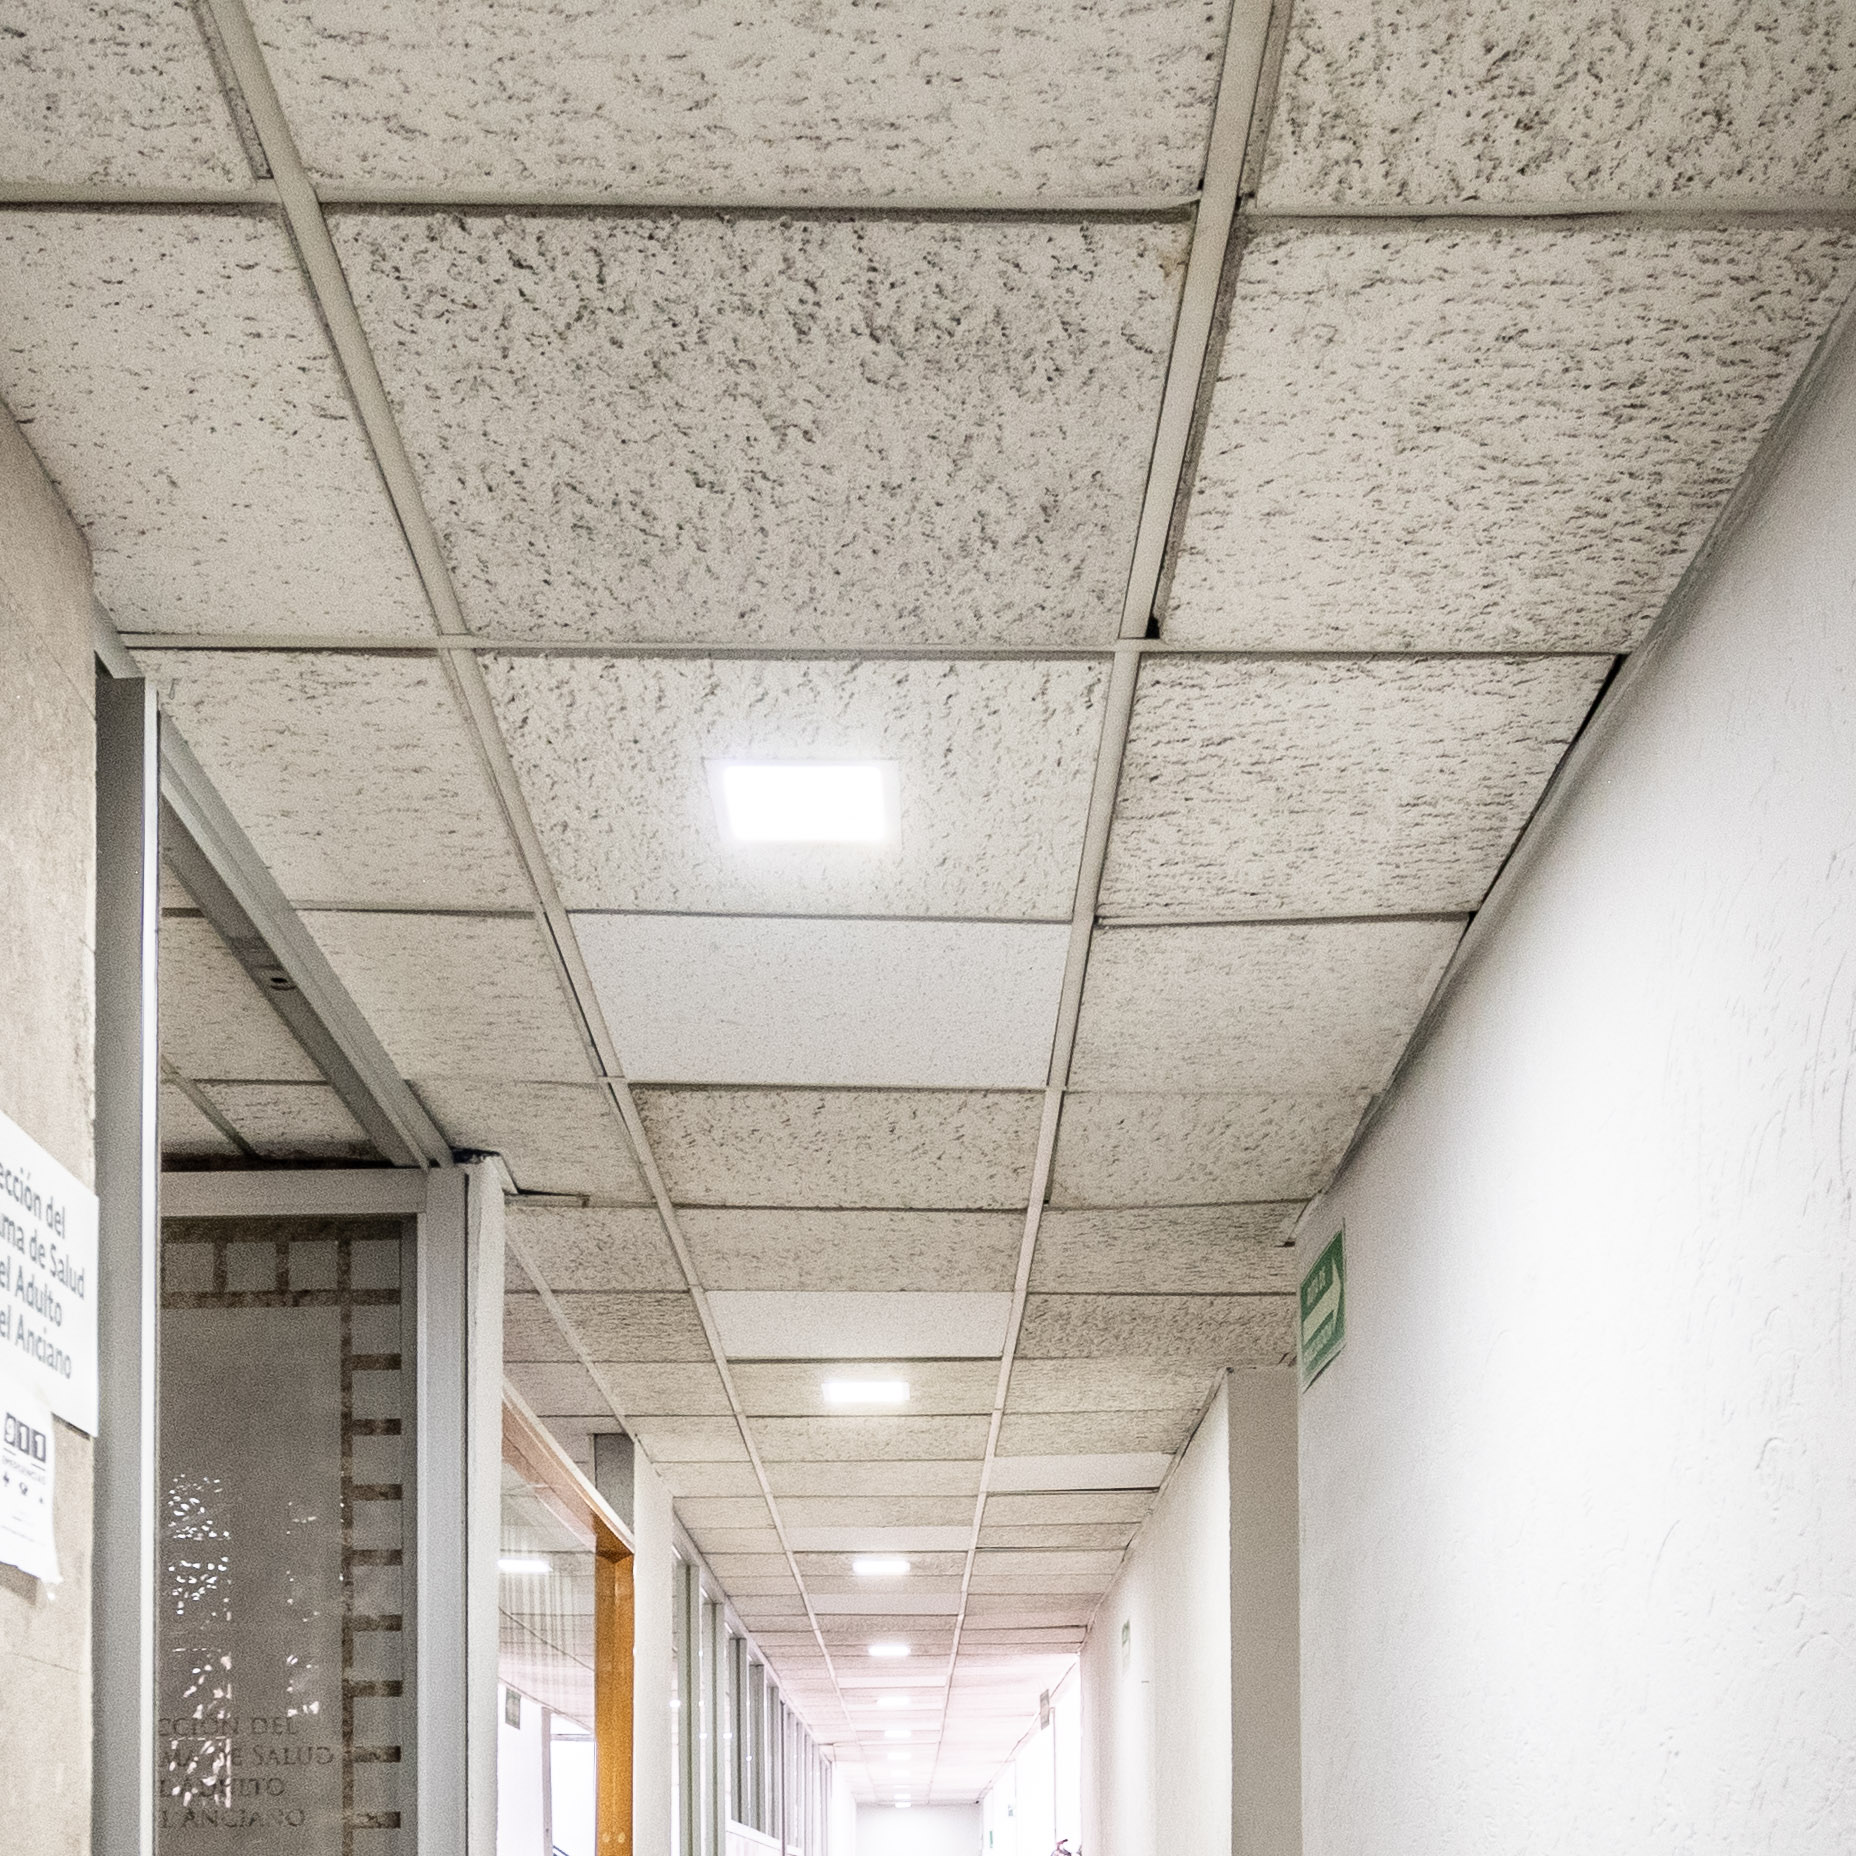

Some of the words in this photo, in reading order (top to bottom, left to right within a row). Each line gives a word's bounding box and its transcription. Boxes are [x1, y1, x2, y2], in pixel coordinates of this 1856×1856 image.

[45, 1196, 65, 1239] del
[29, 1229, 46, 1269] de
[50, 1243, 85, 1300] Salud
[14, 1265, 63, 1327] Adulto
[14, 1313, 72, 1379] Anciano
[4, 1414, 46, 1462] 911
[250, 1716, 299, 1735] DEL
[253, 1744, 334, 1767] SALUD
